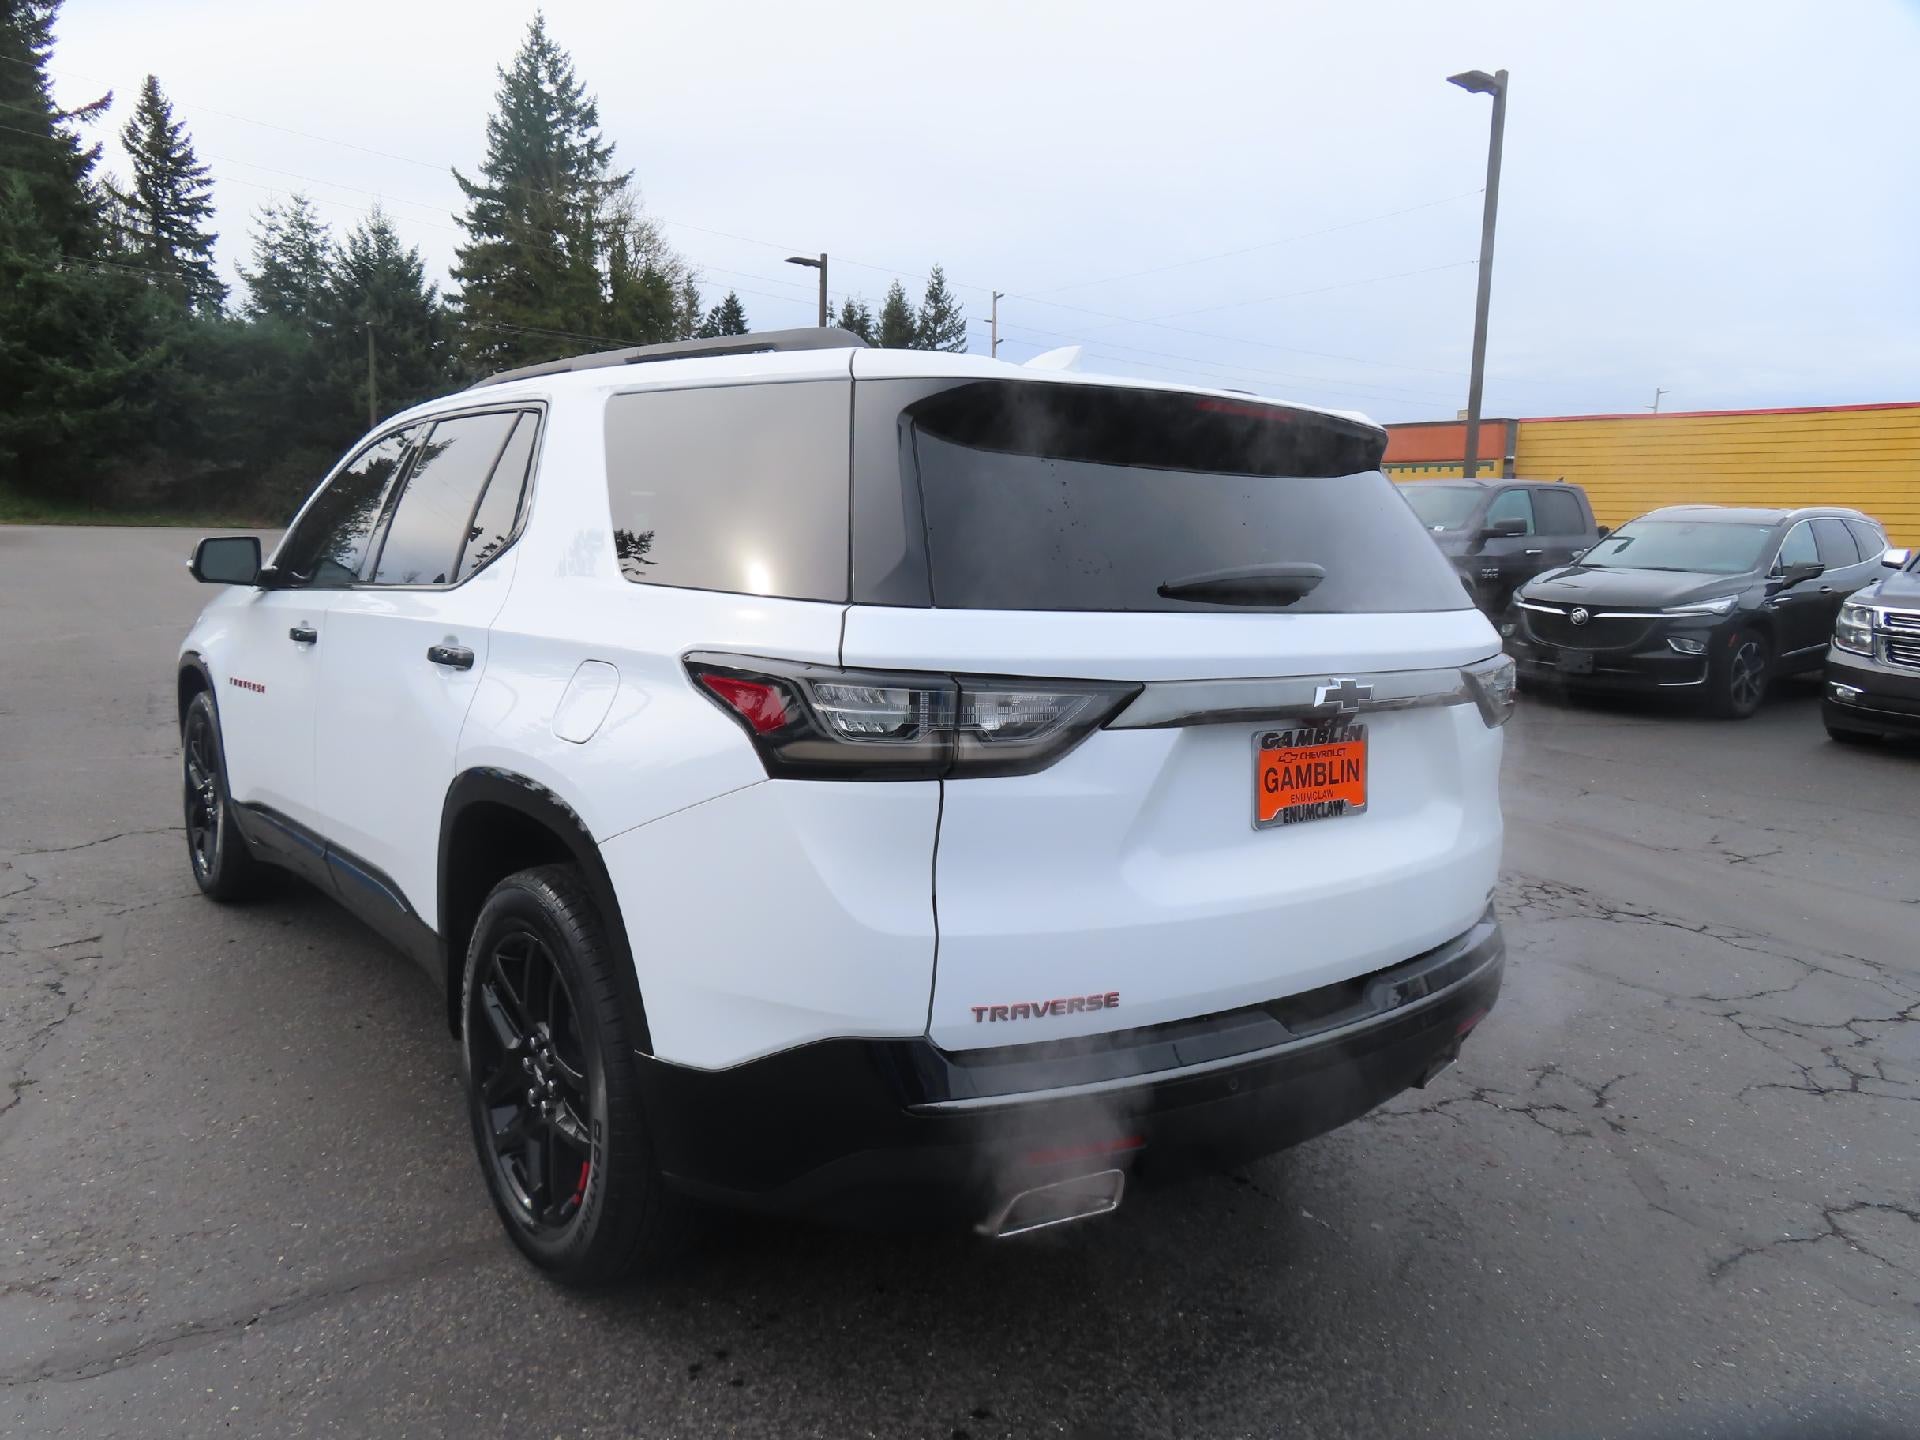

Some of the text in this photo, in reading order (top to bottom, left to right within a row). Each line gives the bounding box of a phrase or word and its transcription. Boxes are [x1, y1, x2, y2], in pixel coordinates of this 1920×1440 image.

[1261, 725, 1364, 749] GAMBLIN
[1299, 747, 1347, 760] CHEVROLET
[1263, 758, 1360, 794] GAMBLIN
[1290, 790, 1334, 804] ENUMCLAW
[1283, 799, 1345, 824] ENUMCLAW
[970, 991, 1120, 1023] TRAVERSE
